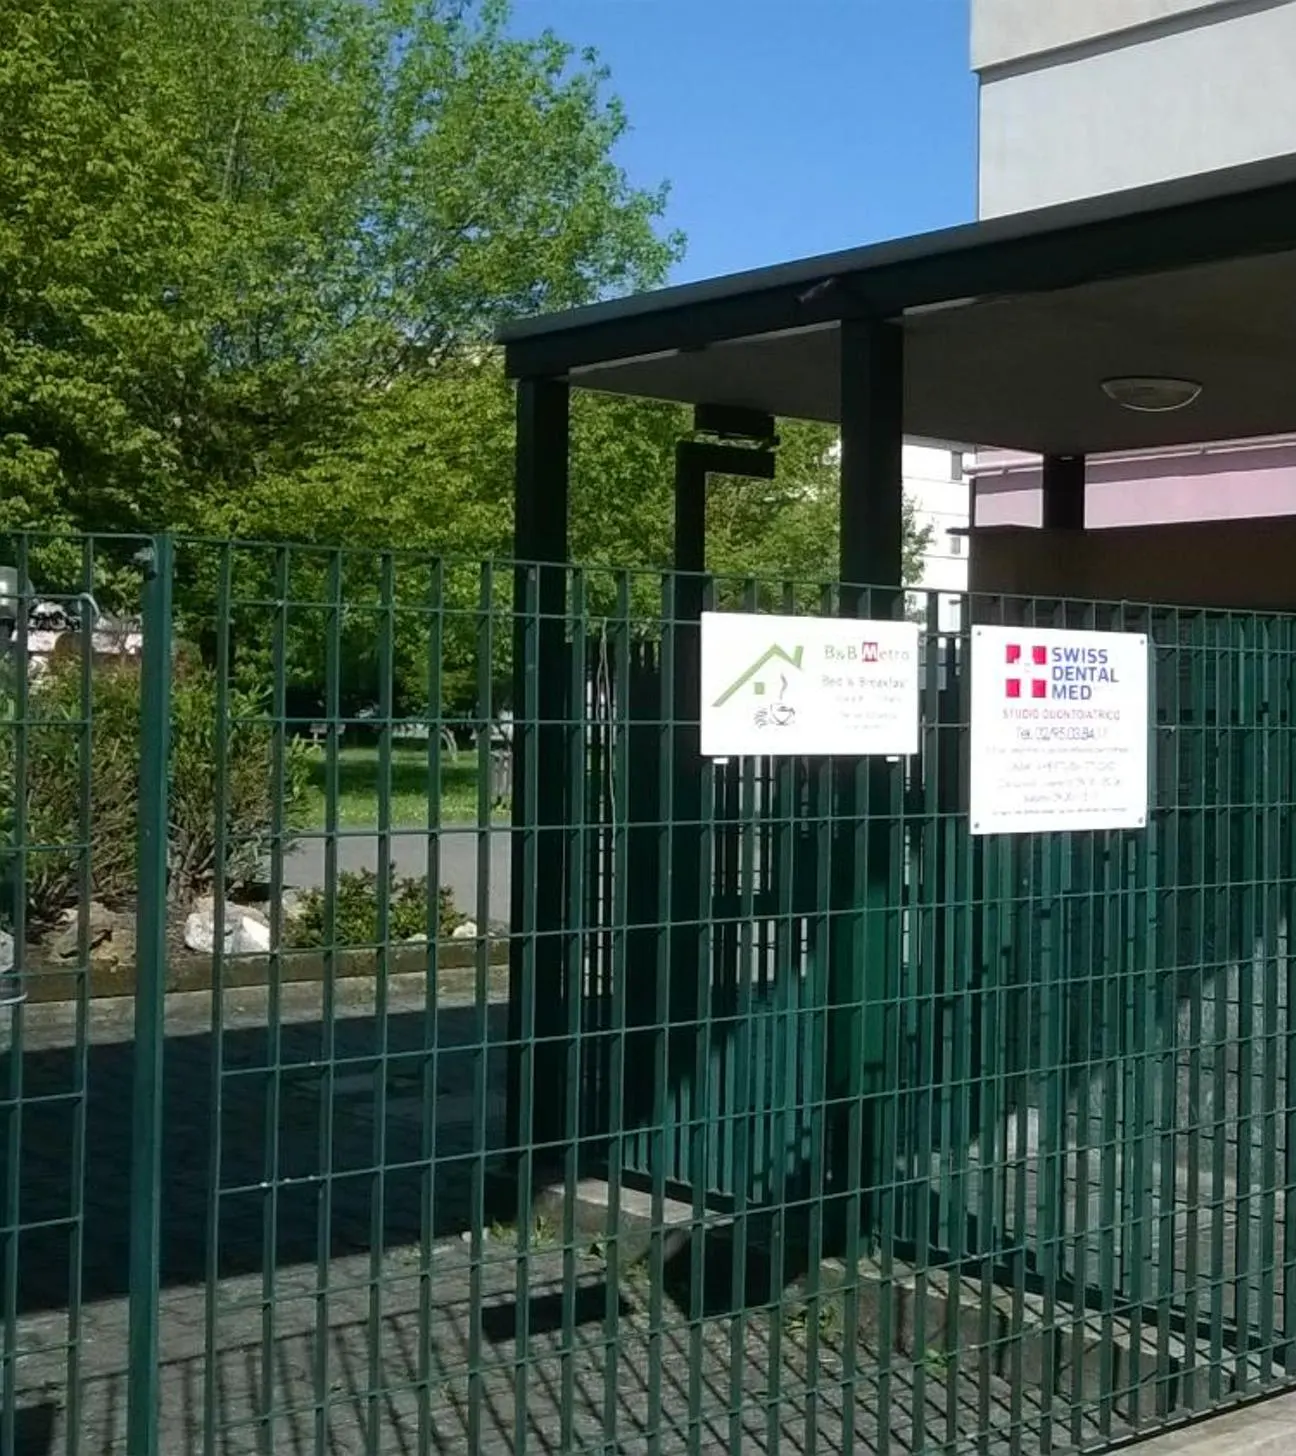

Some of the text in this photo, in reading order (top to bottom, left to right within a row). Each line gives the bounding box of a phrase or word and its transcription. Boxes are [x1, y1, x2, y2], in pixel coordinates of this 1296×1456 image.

[861, 641, 911, 662] Metro
[1051, 647, 1109, 664] SWISS
[1051, 665, 1120, 683] DENTAL
[1051, 683, 1093, 700] MED
[1002, 708, 1039, 720] STUDIO
